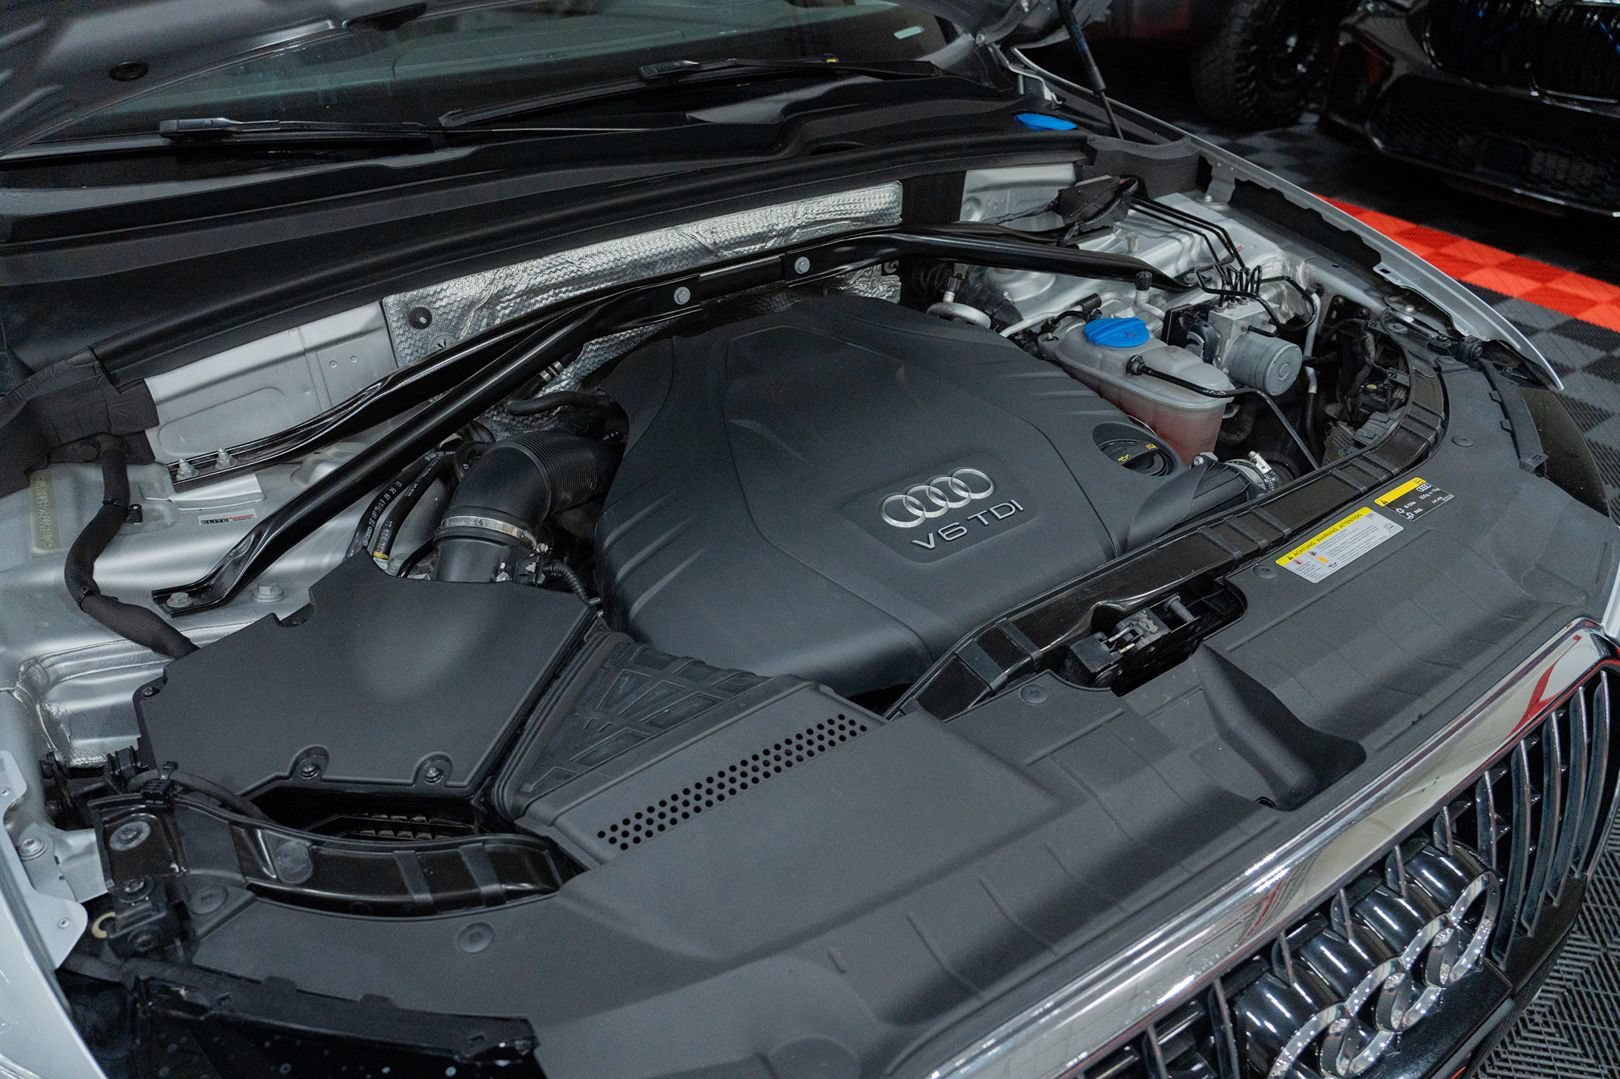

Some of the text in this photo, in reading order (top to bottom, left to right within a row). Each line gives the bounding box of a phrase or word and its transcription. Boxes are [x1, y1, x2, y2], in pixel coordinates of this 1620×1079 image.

[911, 499, 1024, 550] V6 TDI
[1293, 512, 1363, 557] ACHTUNG WARNING ATTENTION
